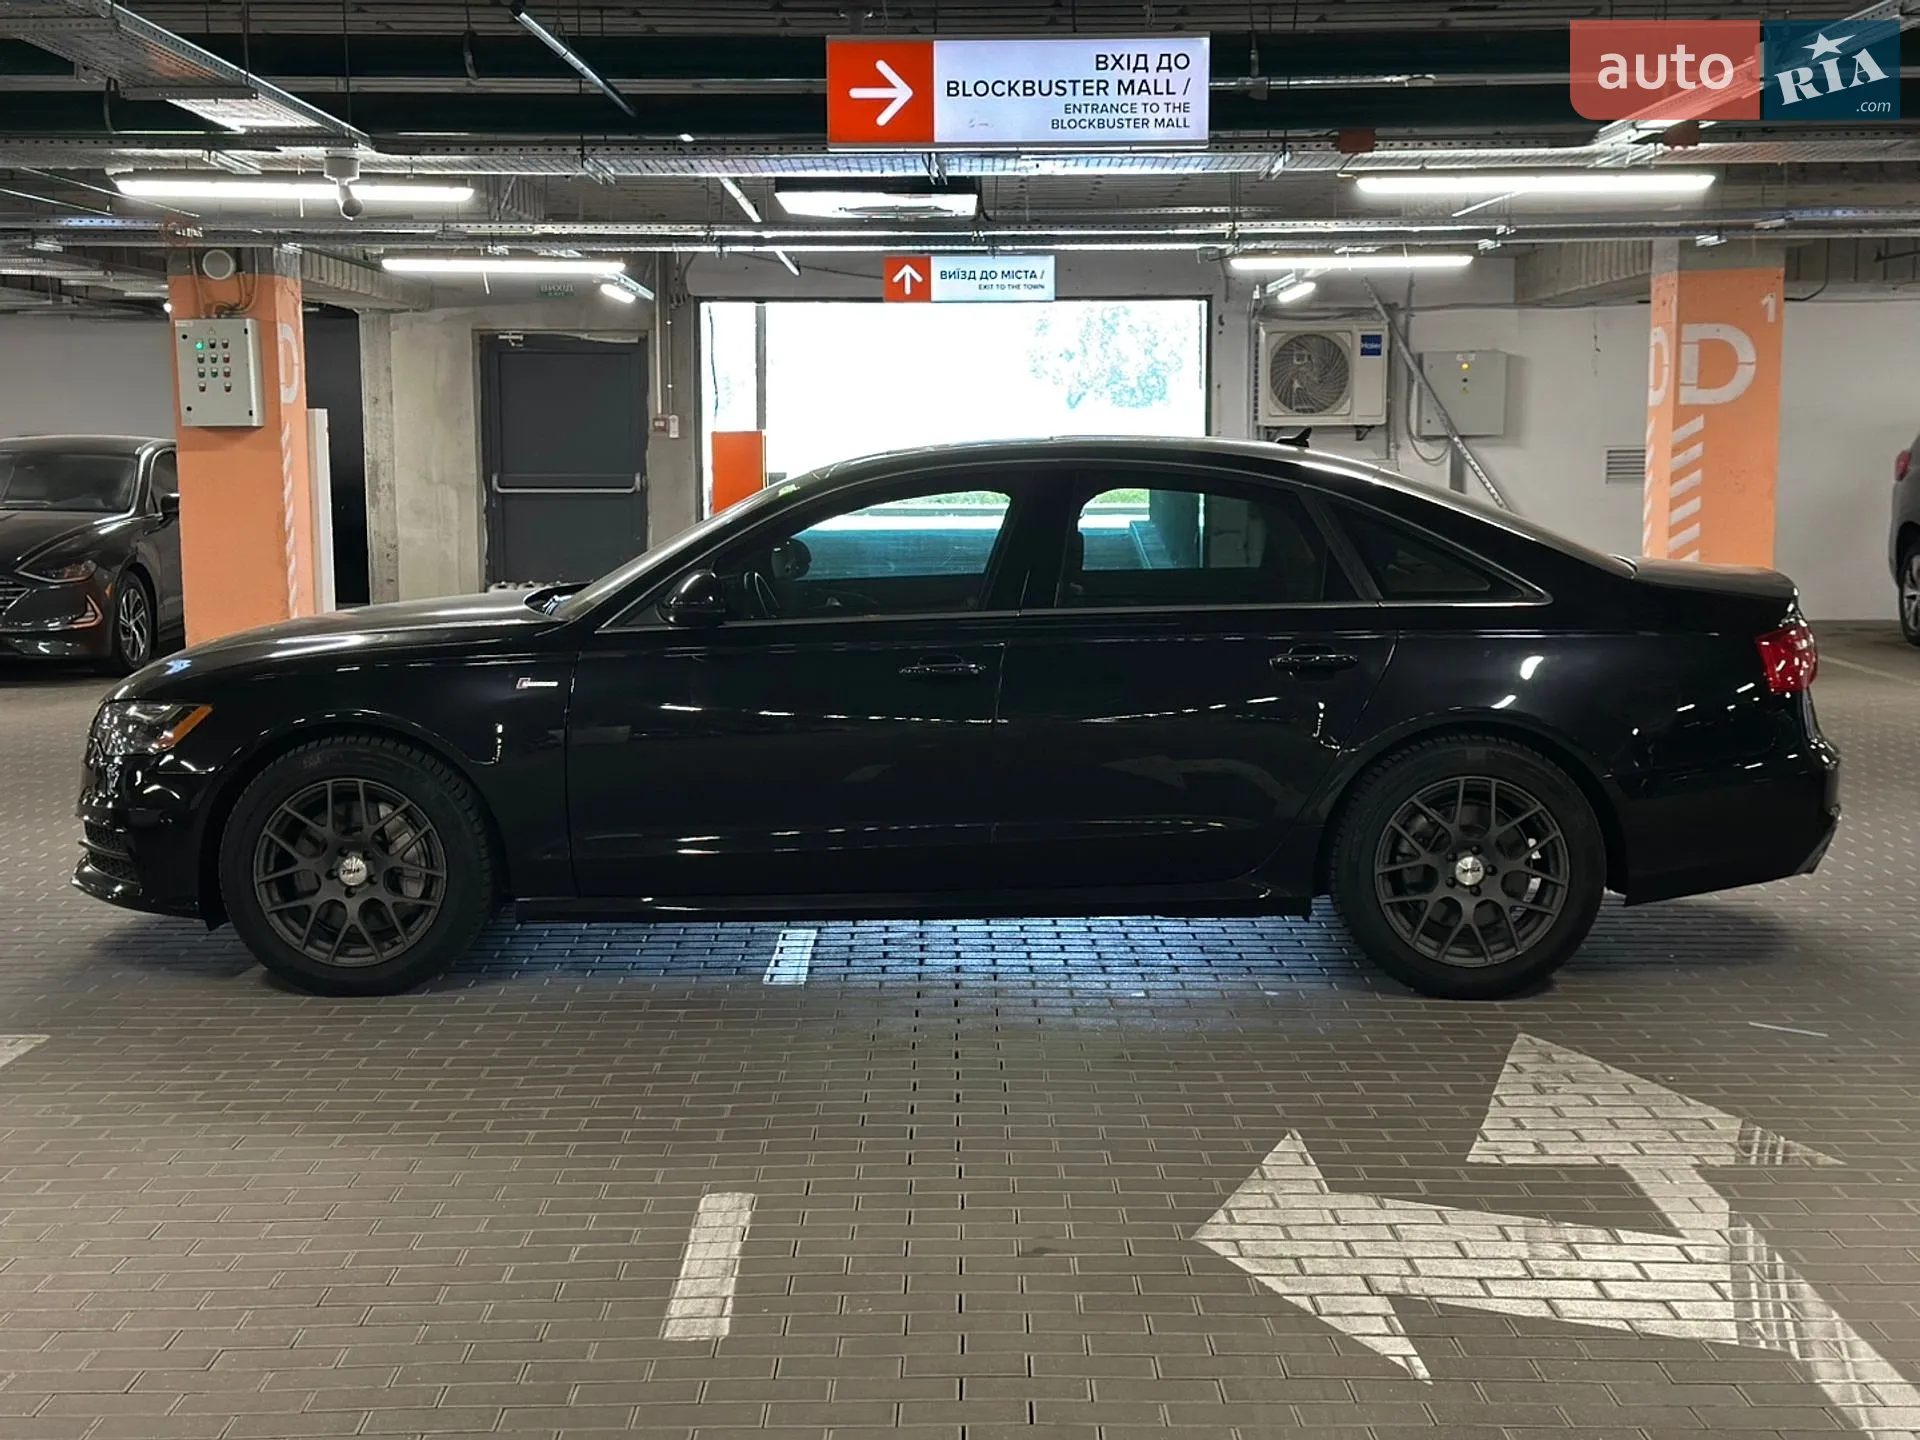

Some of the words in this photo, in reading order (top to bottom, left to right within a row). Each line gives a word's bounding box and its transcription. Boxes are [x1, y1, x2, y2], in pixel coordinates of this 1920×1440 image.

[1095, 53, 1149, 73] ВХІД
[1156, 53, 1191, 73] ДО
[946, 79, 1109, 97] BLOCKBUSTER
[1117, 79, 1176, 96] MALL
[1064, 103, 1137, 114] ENTRANCE
[1141, 103, 1160, 113] TO
[1165, 102, 1191, 113] THE
[1051, 118, 1149, 129] BLOCKBUSTER
[1154, 117, 1190, 128] MALL
[940, 268, 977, 280] ВИЇЗД
[979, 270, 998, 280] ДО
[1001, 270, 1037, 279] МІСТА
[1761, 292, 1777, 323] 1
[1679, 323, 1757, 405] D
